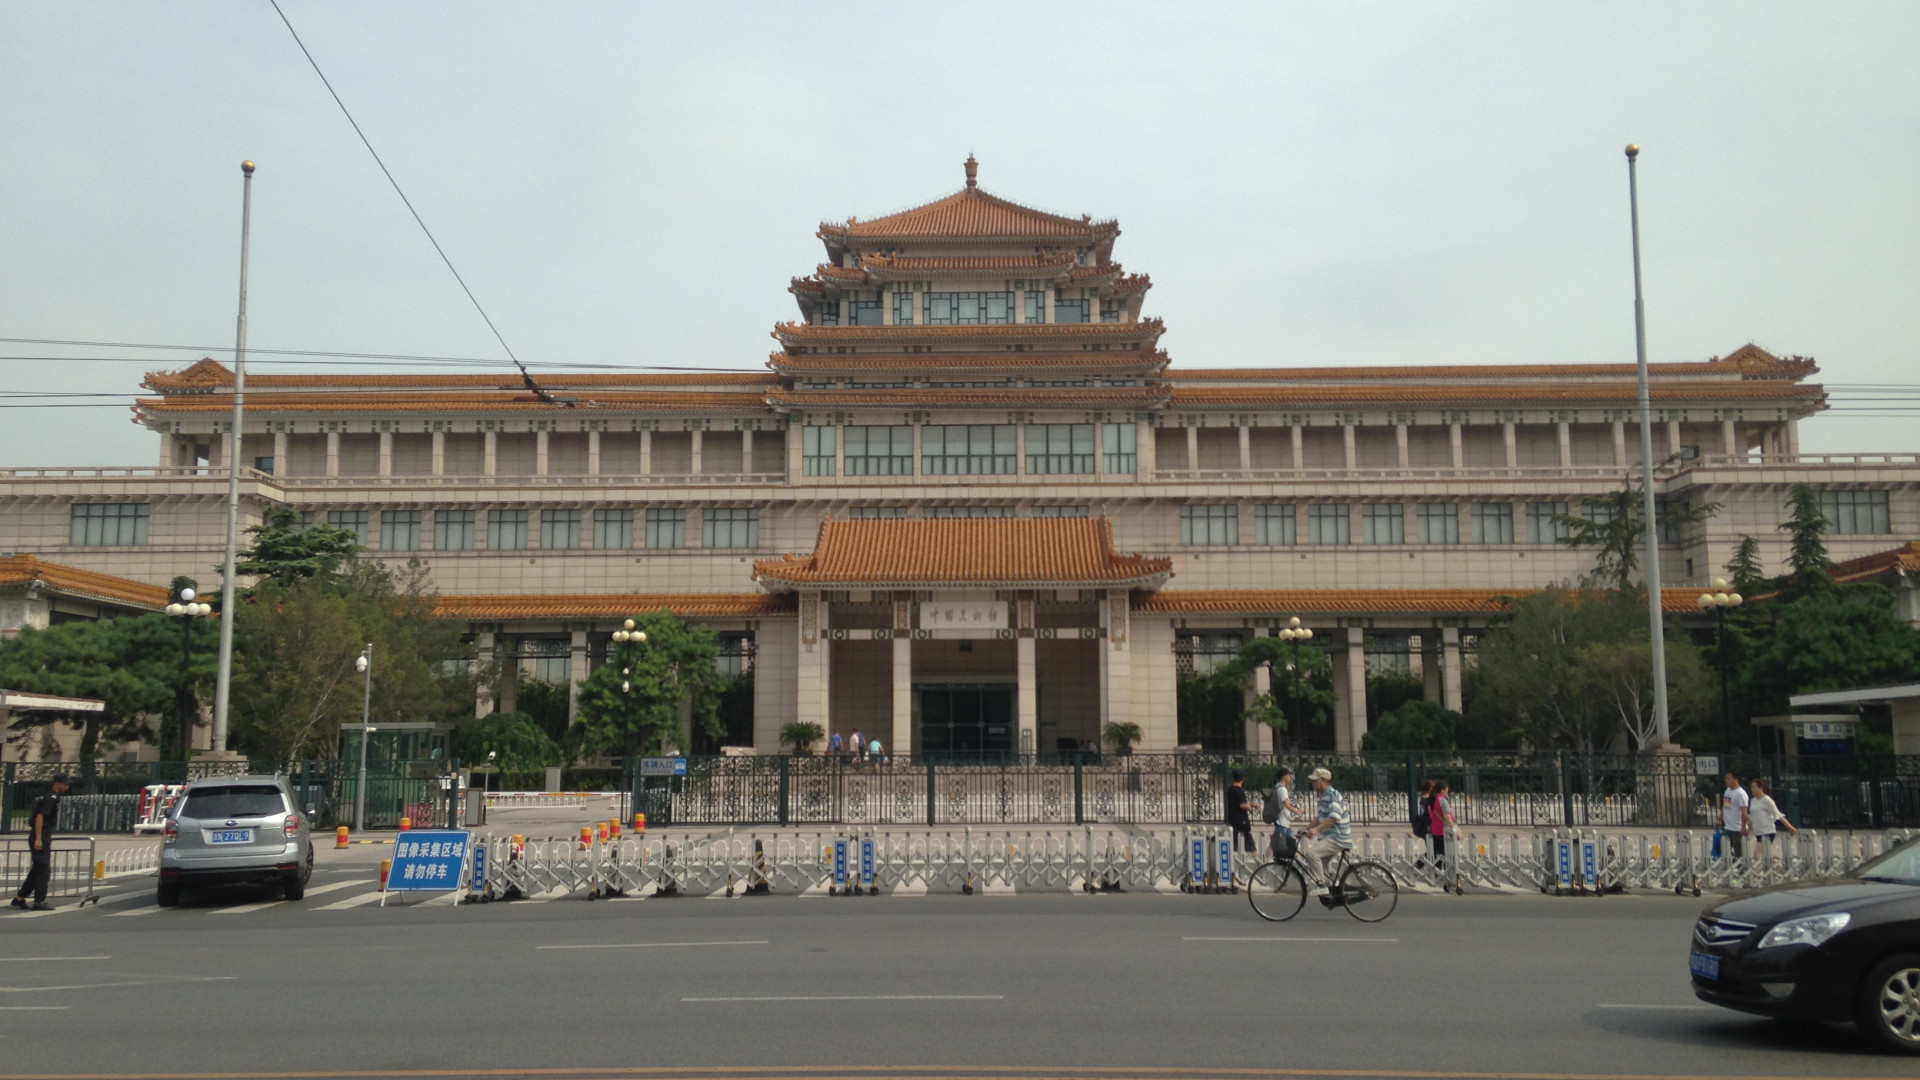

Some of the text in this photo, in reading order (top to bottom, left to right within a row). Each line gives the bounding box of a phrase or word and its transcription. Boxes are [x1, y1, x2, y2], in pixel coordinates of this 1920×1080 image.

[397, 842, 464, 858] 图像采集区域
[404, 863, 448, 880] 请勿停车
